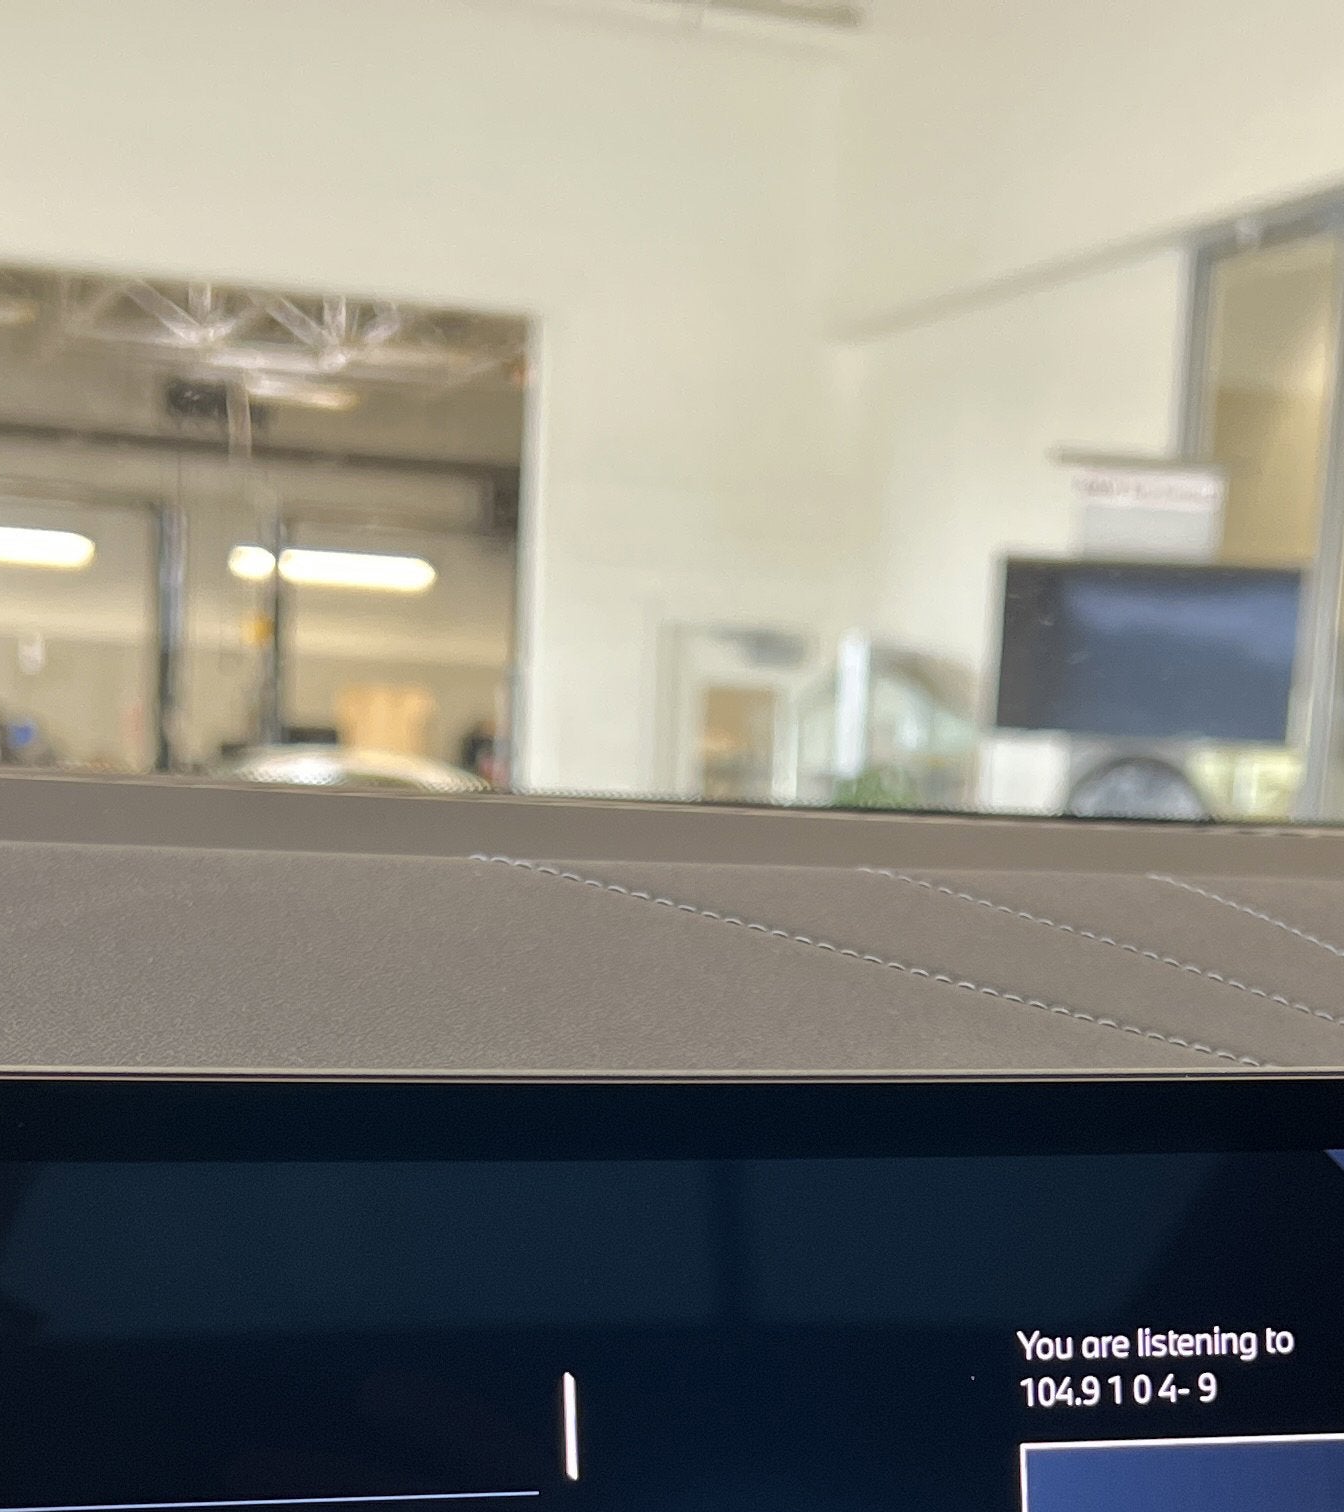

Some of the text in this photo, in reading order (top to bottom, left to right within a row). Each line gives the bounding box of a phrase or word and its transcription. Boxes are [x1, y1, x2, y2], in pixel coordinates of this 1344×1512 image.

[1016, 1326, 1295, 1362] You are listening to
[1020, 1375, 1101, 1408] 104.9
